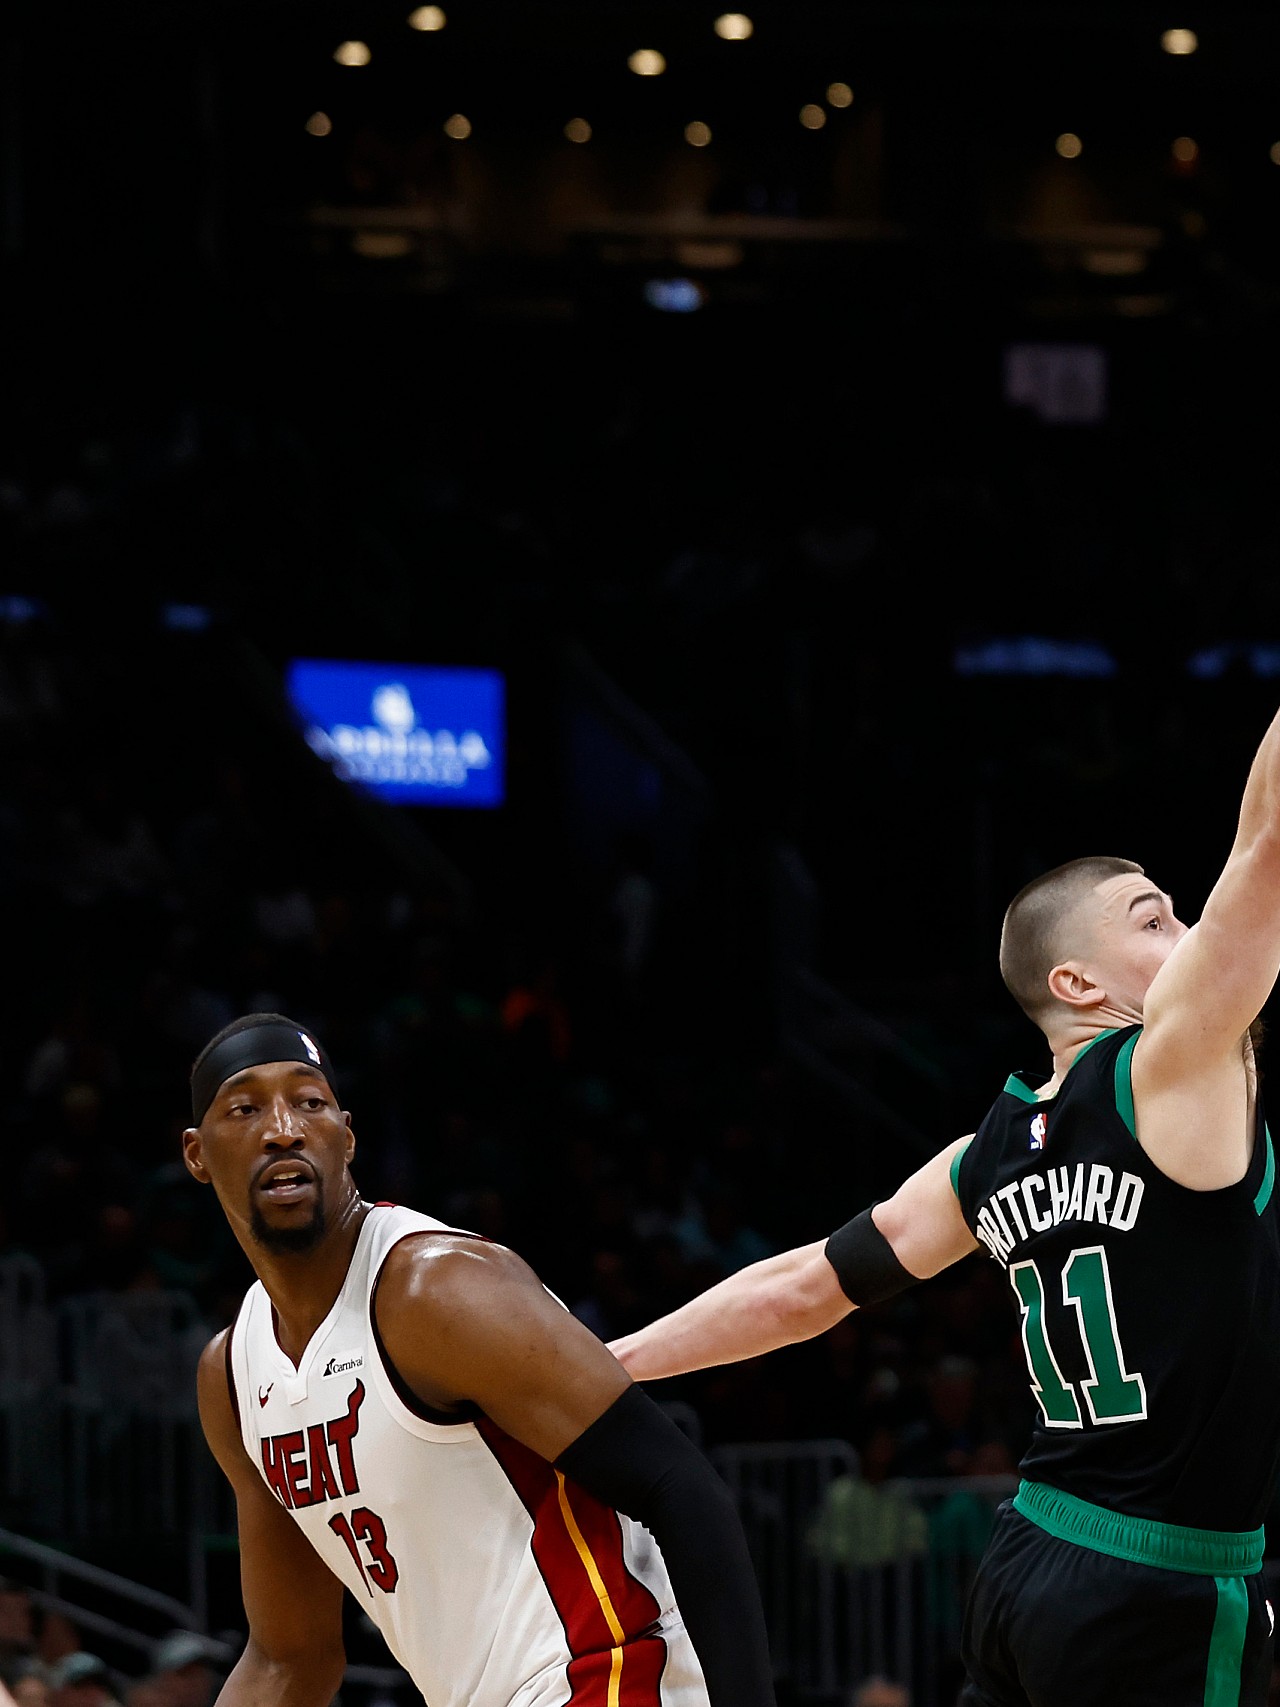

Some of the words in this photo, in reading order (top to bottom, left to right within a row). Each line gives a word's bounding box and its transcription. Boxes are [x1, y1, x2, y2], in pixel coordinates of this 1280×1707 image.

[976, 1163, 1145, 1270] PRITCHARD
[333, 1356, 363, 1374] Carnival
[1009, 1245, 1148, 1429] 11
[261, 1377, 366, 1510] HEAT
[328, 1506, 399, 1598] 13
